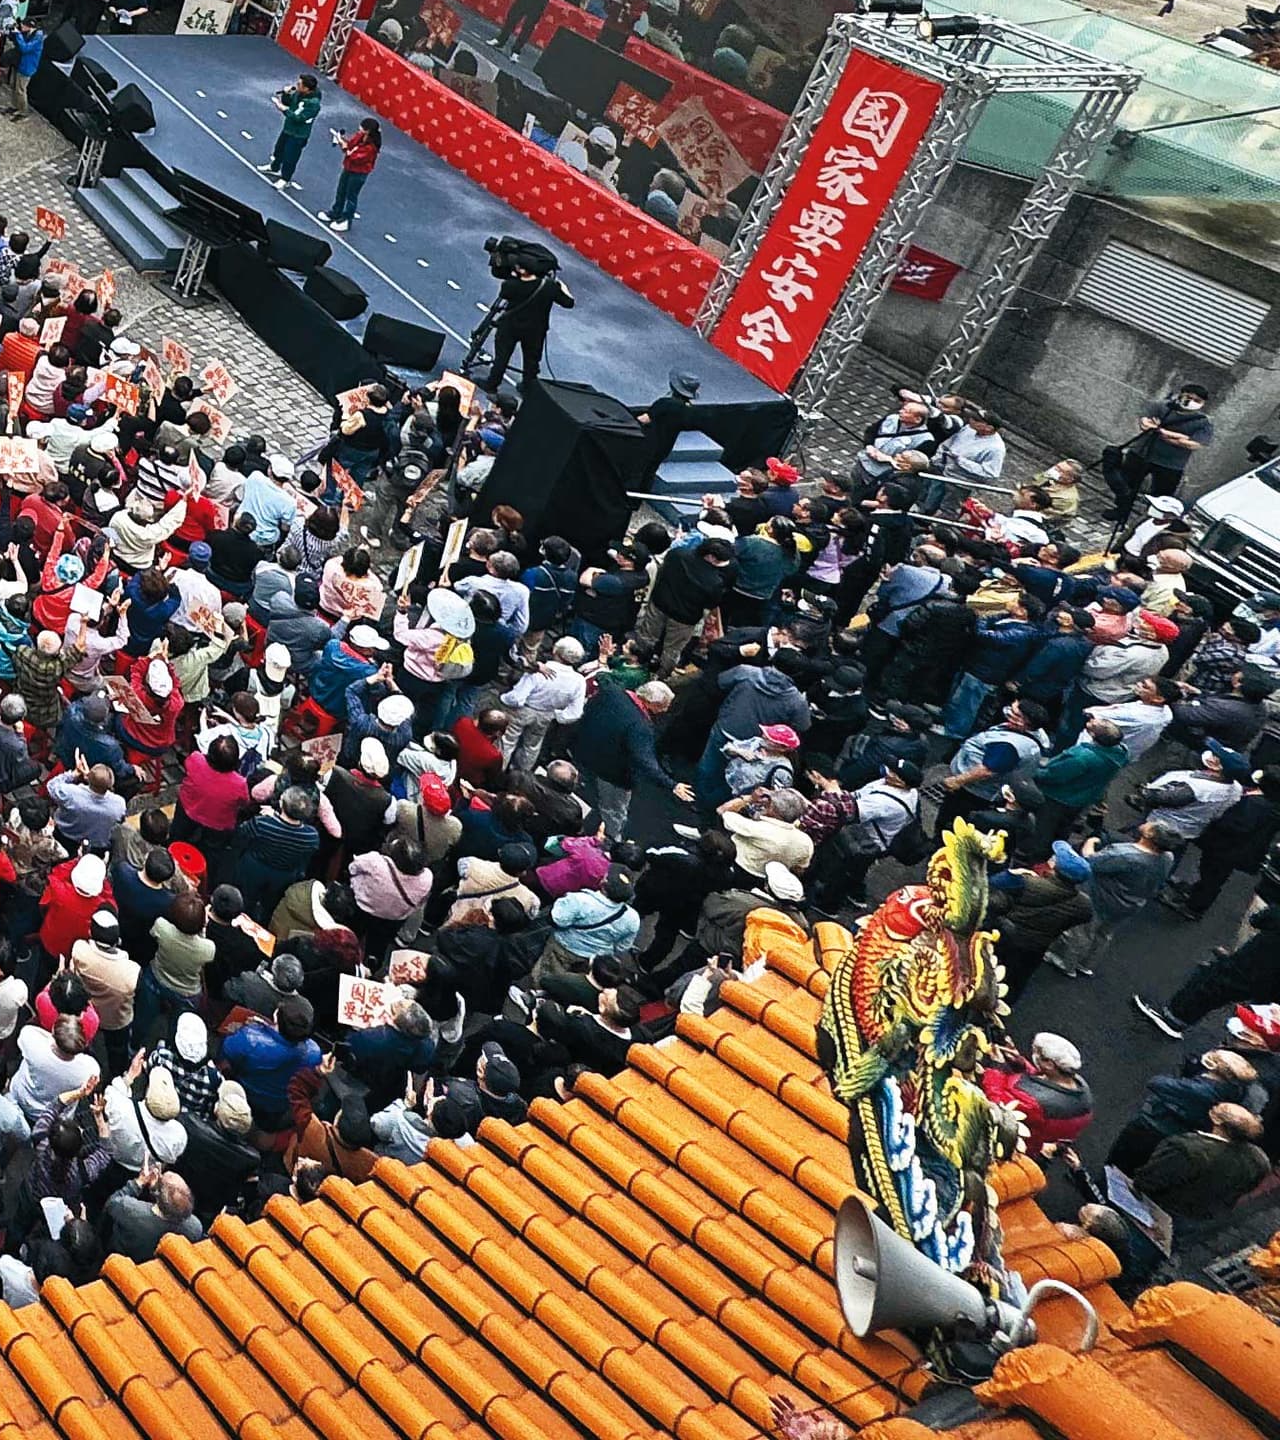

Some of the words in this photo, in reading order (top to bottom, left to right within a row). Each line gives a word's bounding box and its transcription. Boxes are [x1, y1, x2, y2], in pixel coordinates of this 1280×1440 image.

[736, 87, 908, 361] 國家要安全
